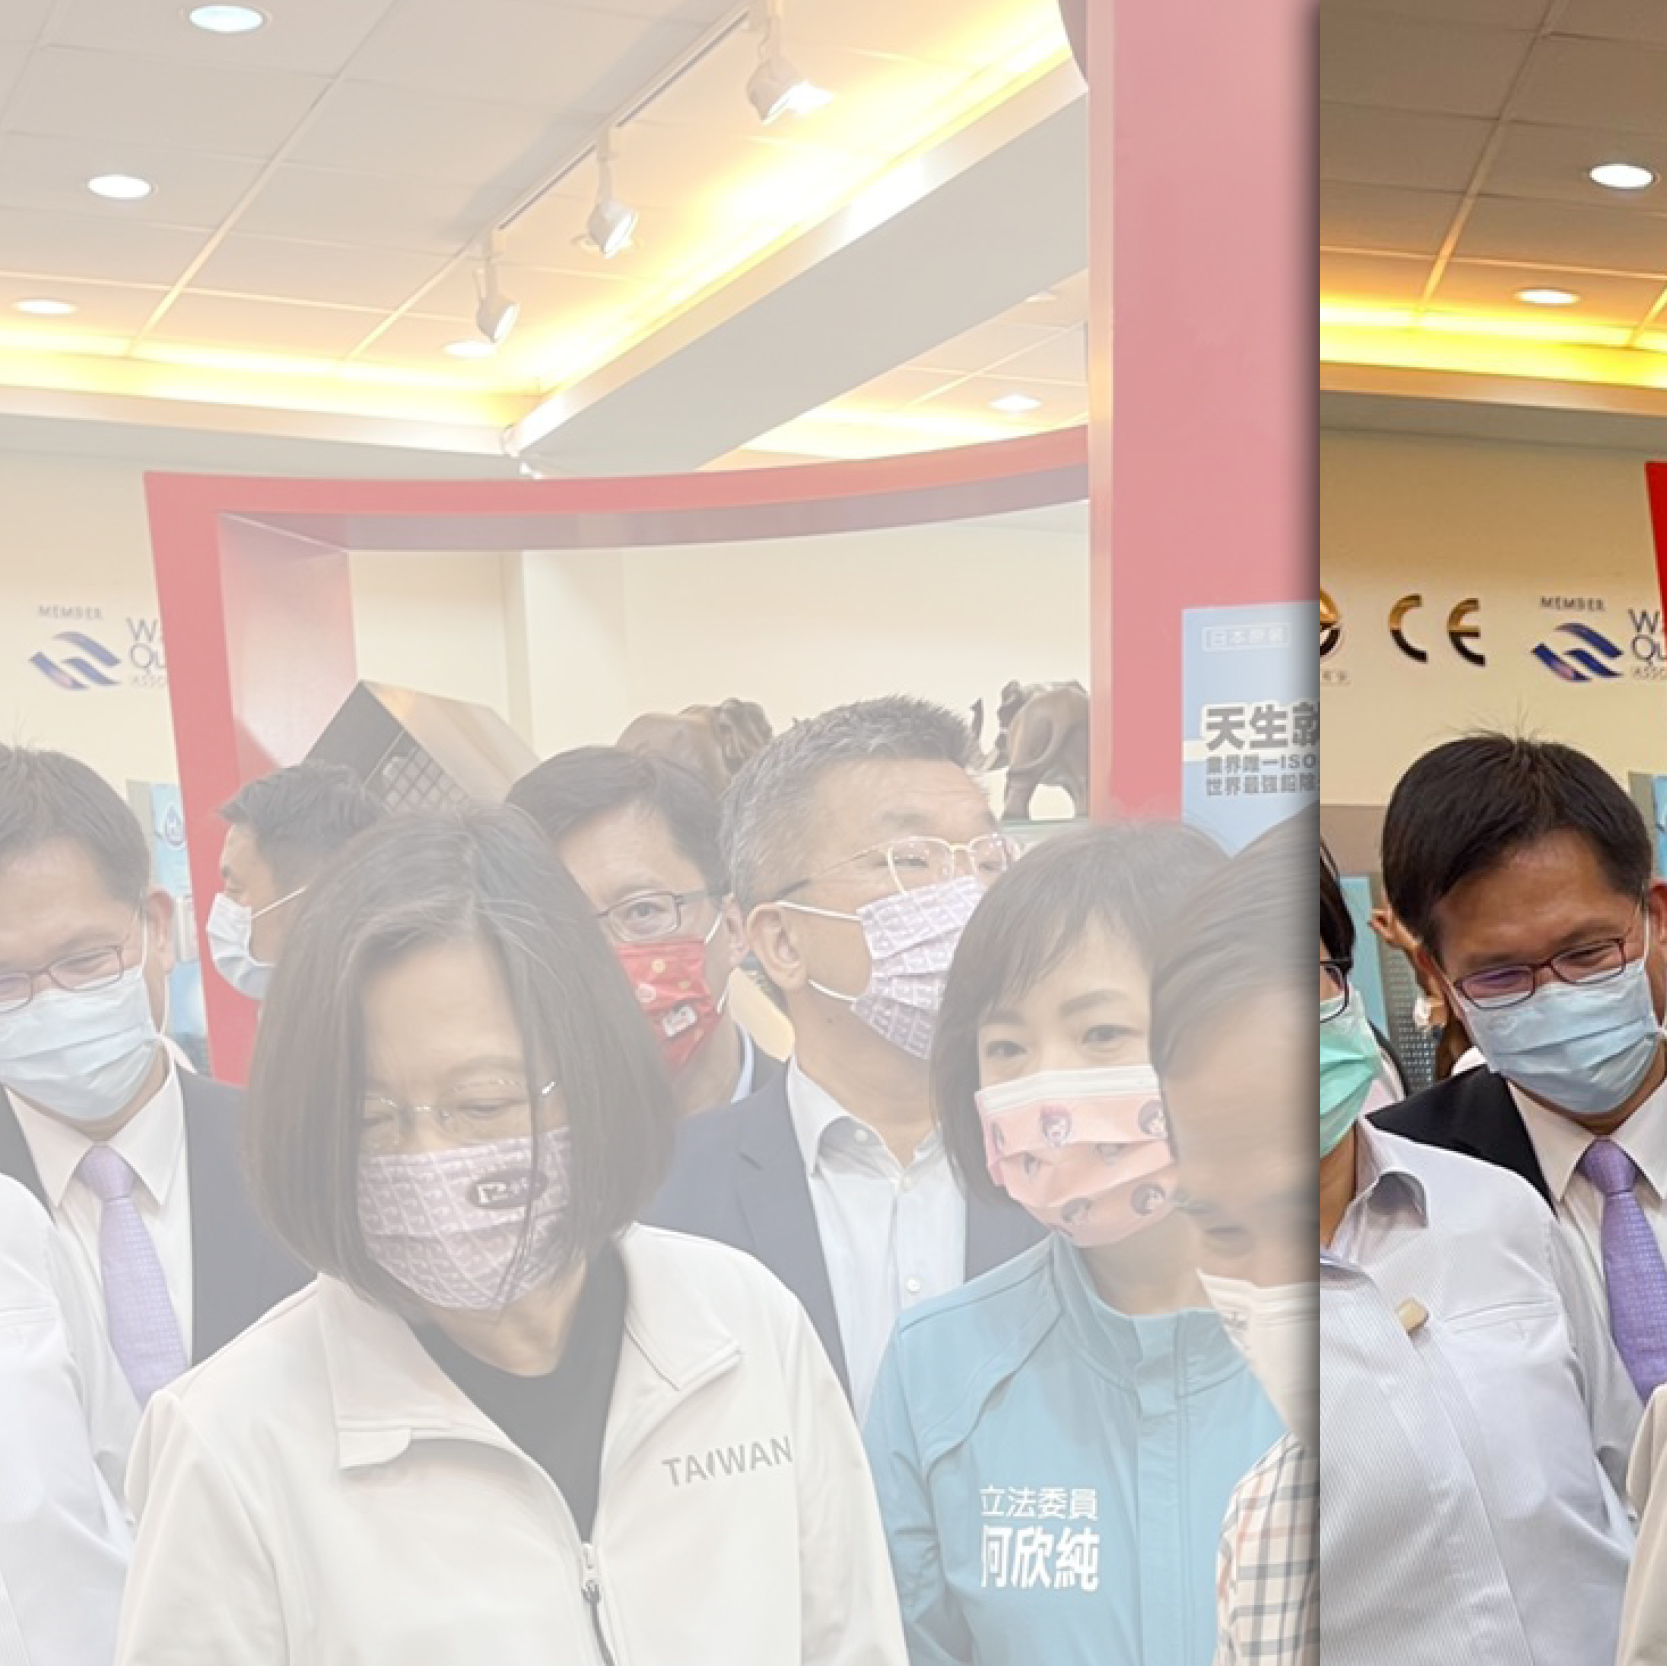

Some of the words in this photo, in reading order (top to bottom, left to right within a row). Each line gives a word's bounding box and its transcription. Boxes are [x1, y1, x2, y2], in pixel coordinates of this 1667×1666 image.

[1389, 593, 1486, 667] CE
[1540, 596, 1605, 612] MEMBER
[662, 1436, 794, 1488] TAIWAN
[980, 1484, 1098, 1522] 立法委員
[980, 1524, 1100, 1592] 何欣純
